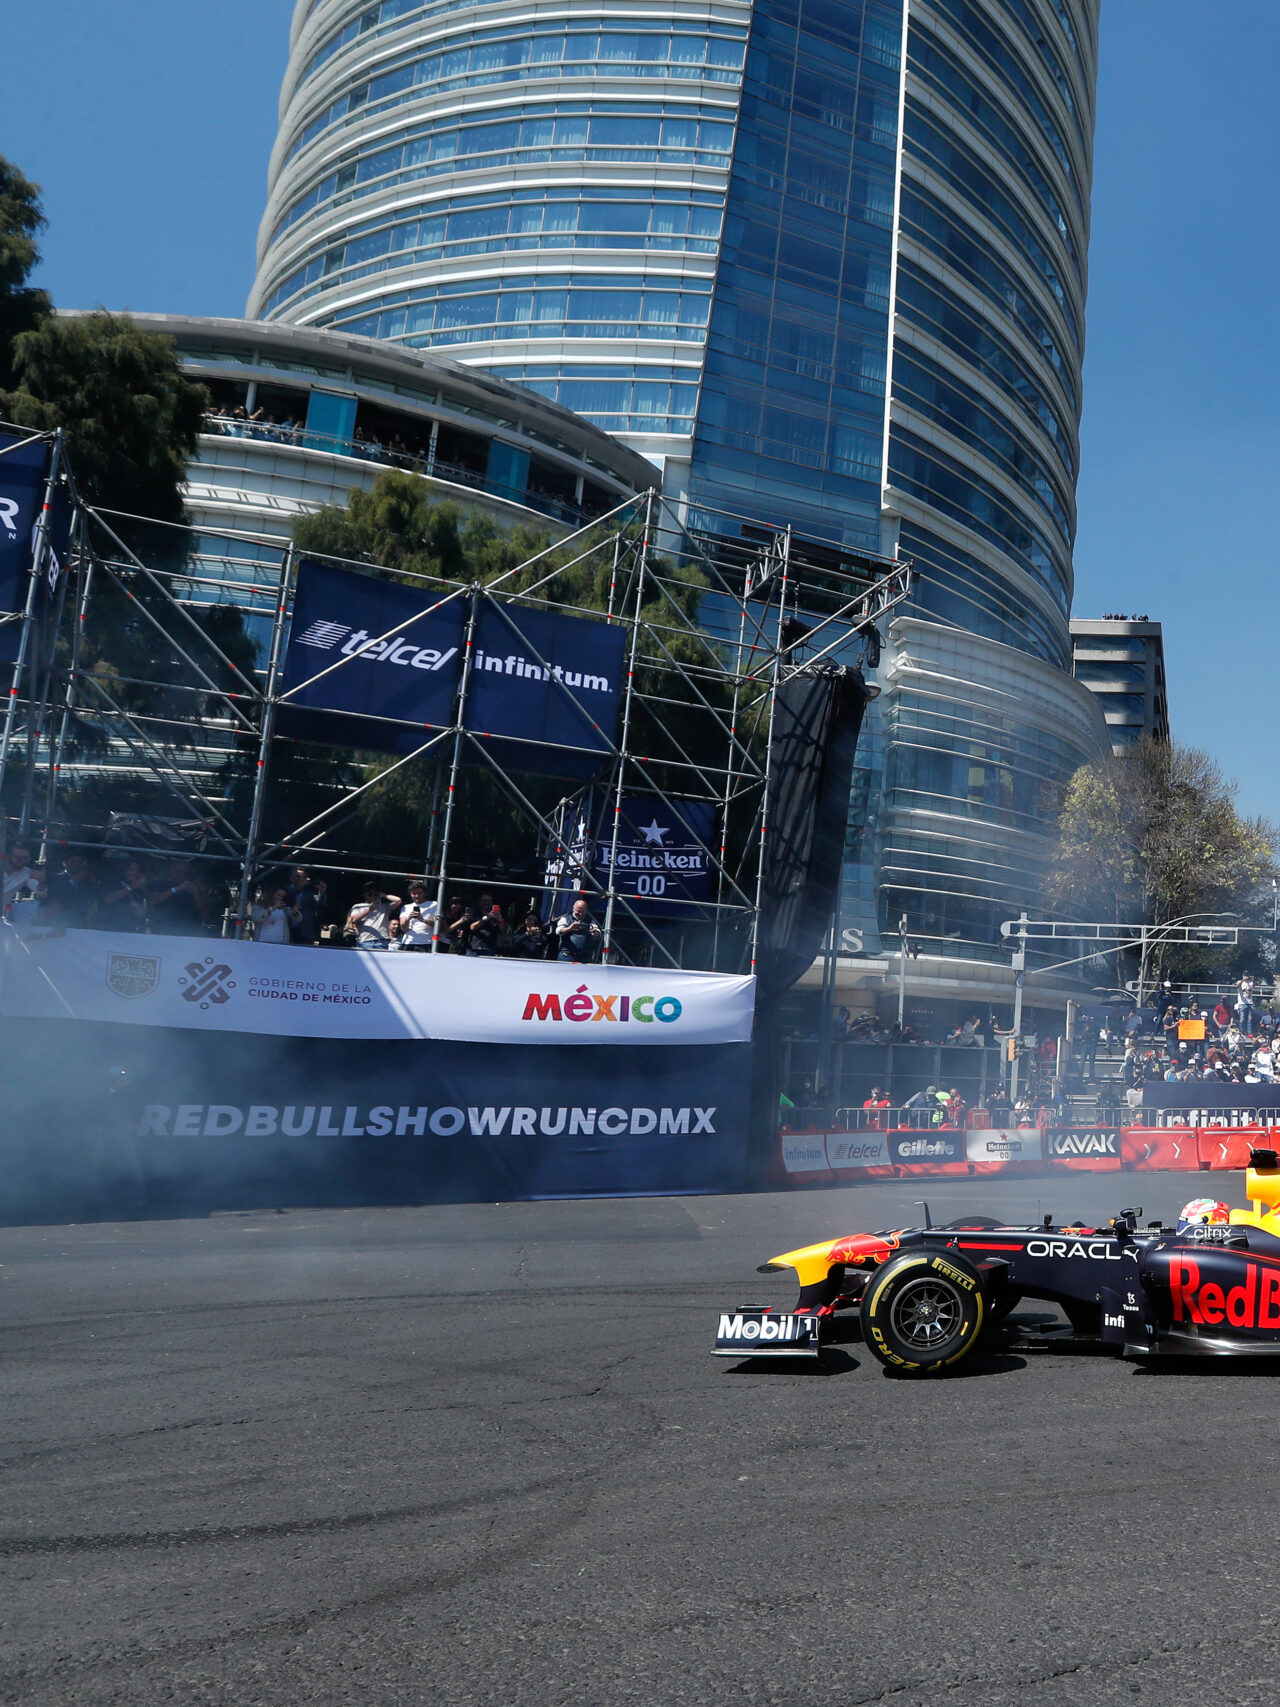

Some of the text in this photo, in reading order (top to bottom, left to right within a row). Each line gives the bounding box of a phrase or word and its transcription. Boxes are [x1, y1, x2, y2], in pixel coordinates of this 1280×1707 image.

[341, 629, 458, 671] telcel
[601, 847, 704, 870] Heineken
[249, 976, 372, 993] GOBIERNO DE LA
[248, 988, 371, 1005] CIUDAD DE MÉXICO
[847, 1142, 883, 1159] telcel
[897, 1140, 955, 1157] Gillette
[1048, 1134, 1116, 1155] KAVAK
[1194, 1226, 1232, 1240] citrix
[1027, 1241, 1121, 1259] ORACL
[931, 1257, 976, 1291] PIRELLI
[717, 1314, 793, 1340] Mobil
